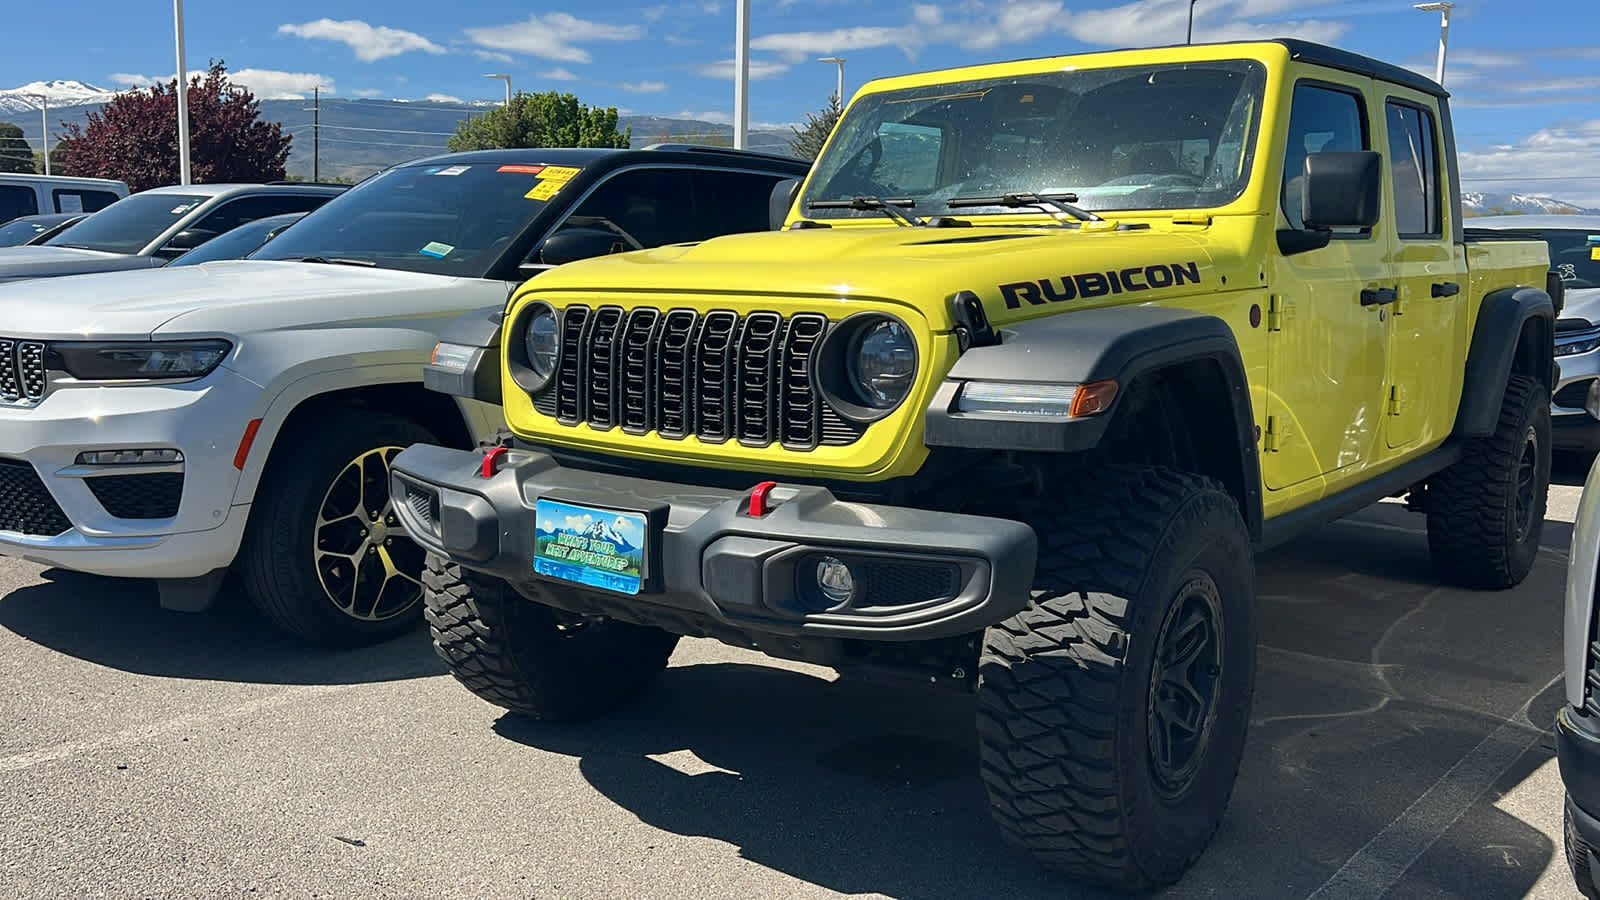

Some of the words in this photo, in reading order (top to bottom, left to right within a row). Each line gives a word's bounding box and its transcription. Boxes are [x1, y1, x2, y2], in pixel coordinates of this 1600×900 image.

[998, 262, 1200, 310] RUBICON
[545, 543, 569, 558] NEXT
[568, 549, 628, 571] ADVENTURE?
[590, 539, 615, 554] YOUR
